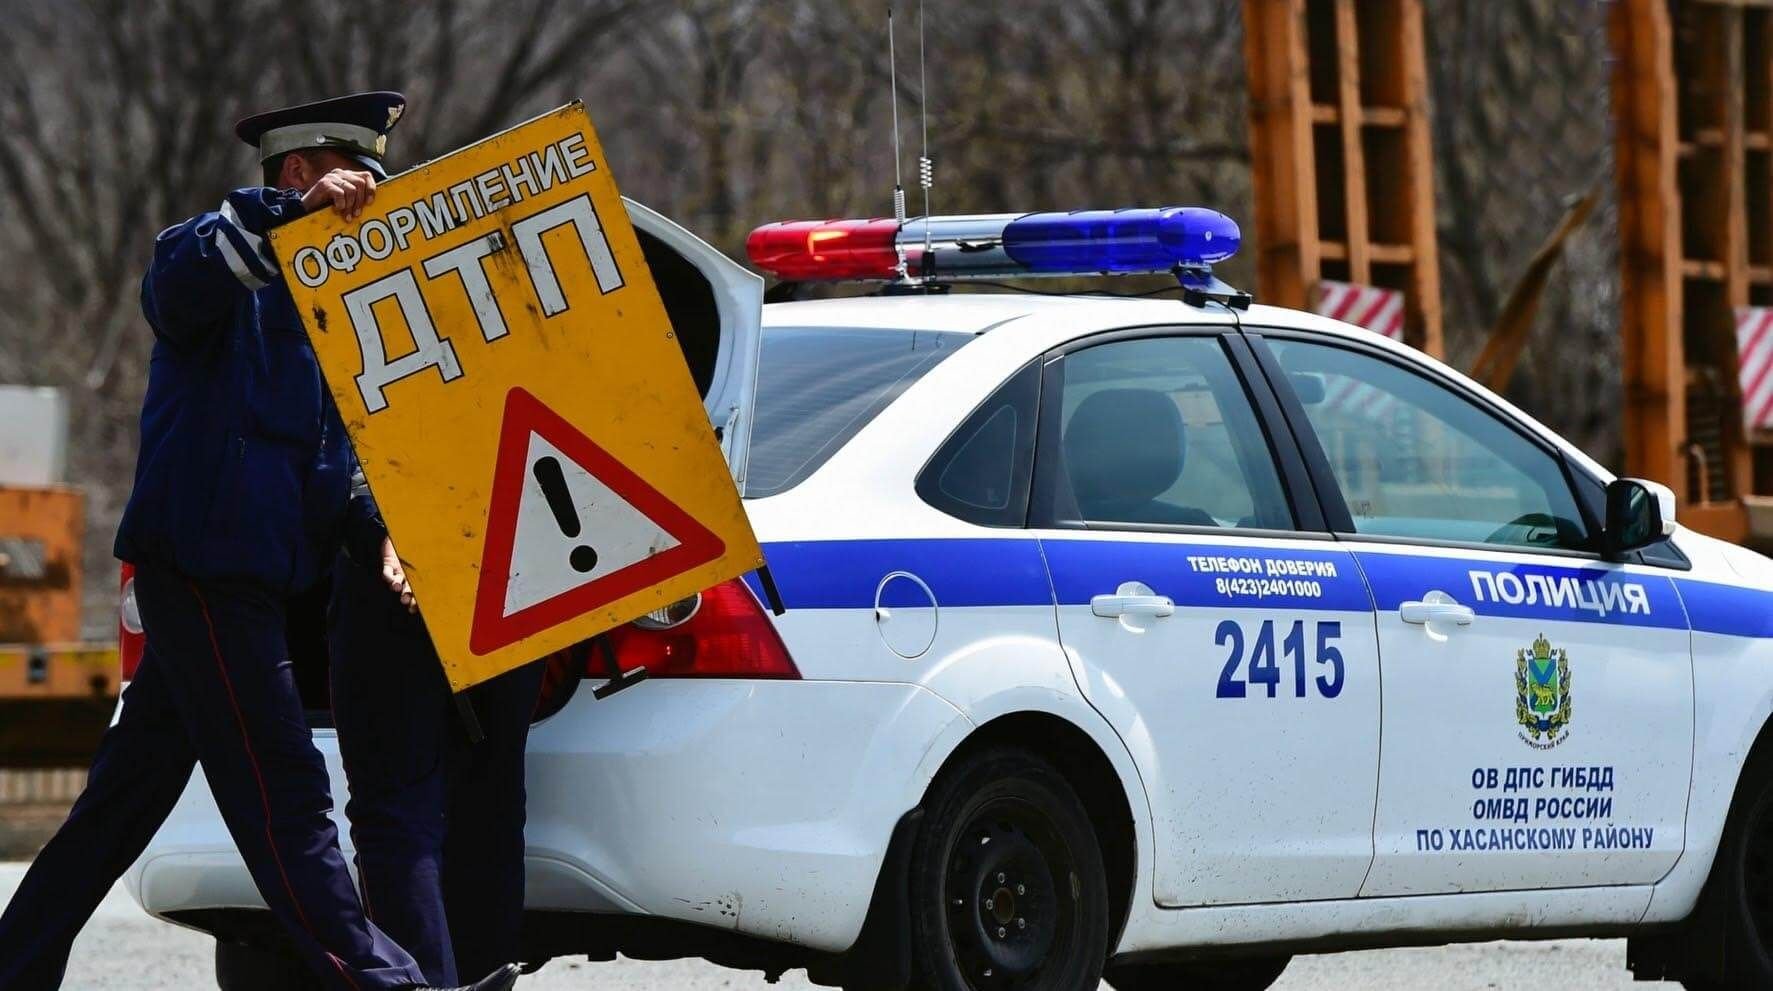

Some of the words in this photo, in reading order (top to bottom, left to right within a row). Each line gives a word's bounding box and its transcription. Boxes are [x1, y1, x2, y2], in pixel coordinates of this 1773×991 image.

[293, 132, 596, 289] ОФОРМЛЕНИЕ
[341, 193, 625, 415] ДТП
[1187, 556, 1262, 575] ТЕЛЕФОН
[1267, 559, 1337, 577] ДОВЕРИЯ
[1215, 578, 1322, 598] 8(423)2401000
[1468, 570, 1651, 617] ПОЛИЦИЯ
[1214, 619, 1345, 699] 2415
[1472, 767, 1498, 789] ОВ
[1503, 767, 1545, 792] ДПС
[1551, 766, 1614, 791] ГИБДД
[1473, 798, 1529, 823] ОМВД
[1535, 797, 1612, 819] РОССИИ
[1416, 830, 1444, 851] ПО
[1450, 829, 1576, 850] ХАСАНСКОМУ
[1583, 825, 1654, 849] РАЙОНУ
